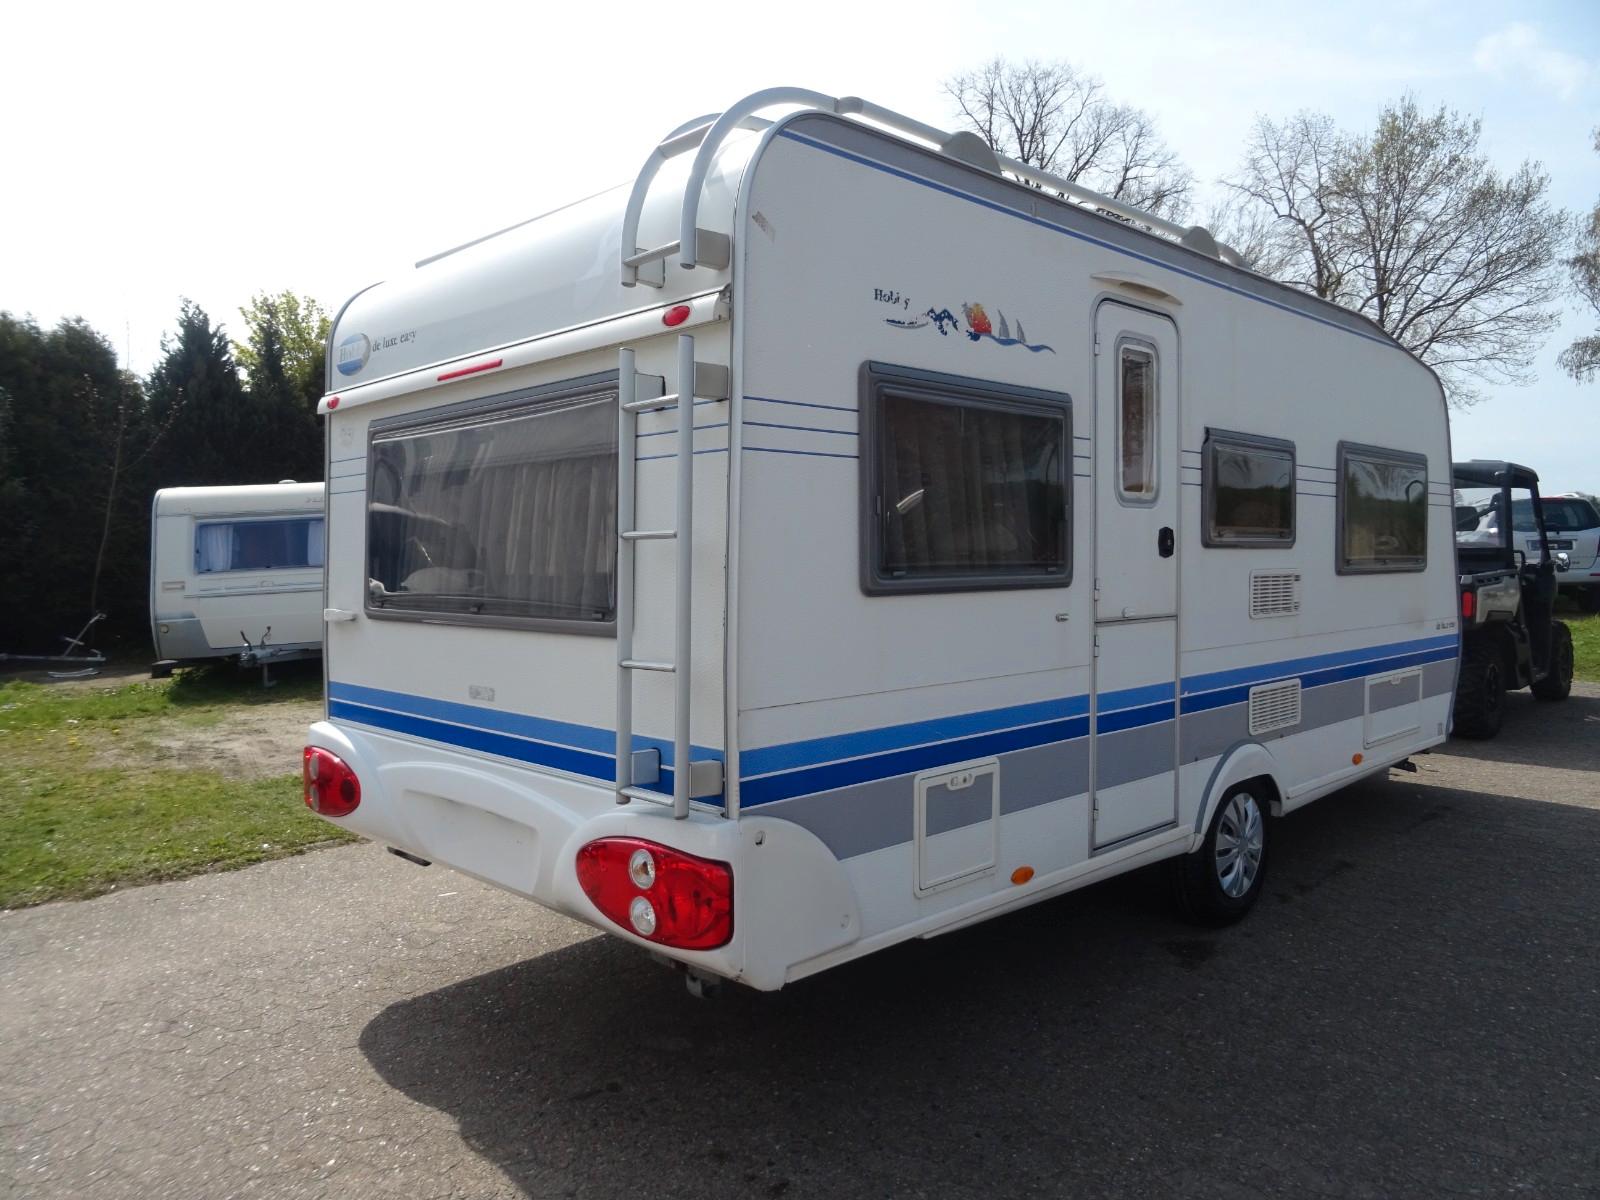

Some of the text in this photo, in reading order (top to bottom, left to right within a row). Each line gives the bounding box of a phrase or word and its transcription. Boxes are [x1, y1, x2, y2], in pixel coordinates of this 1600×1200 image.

[372, 329, 416, 352] de luxe easy
